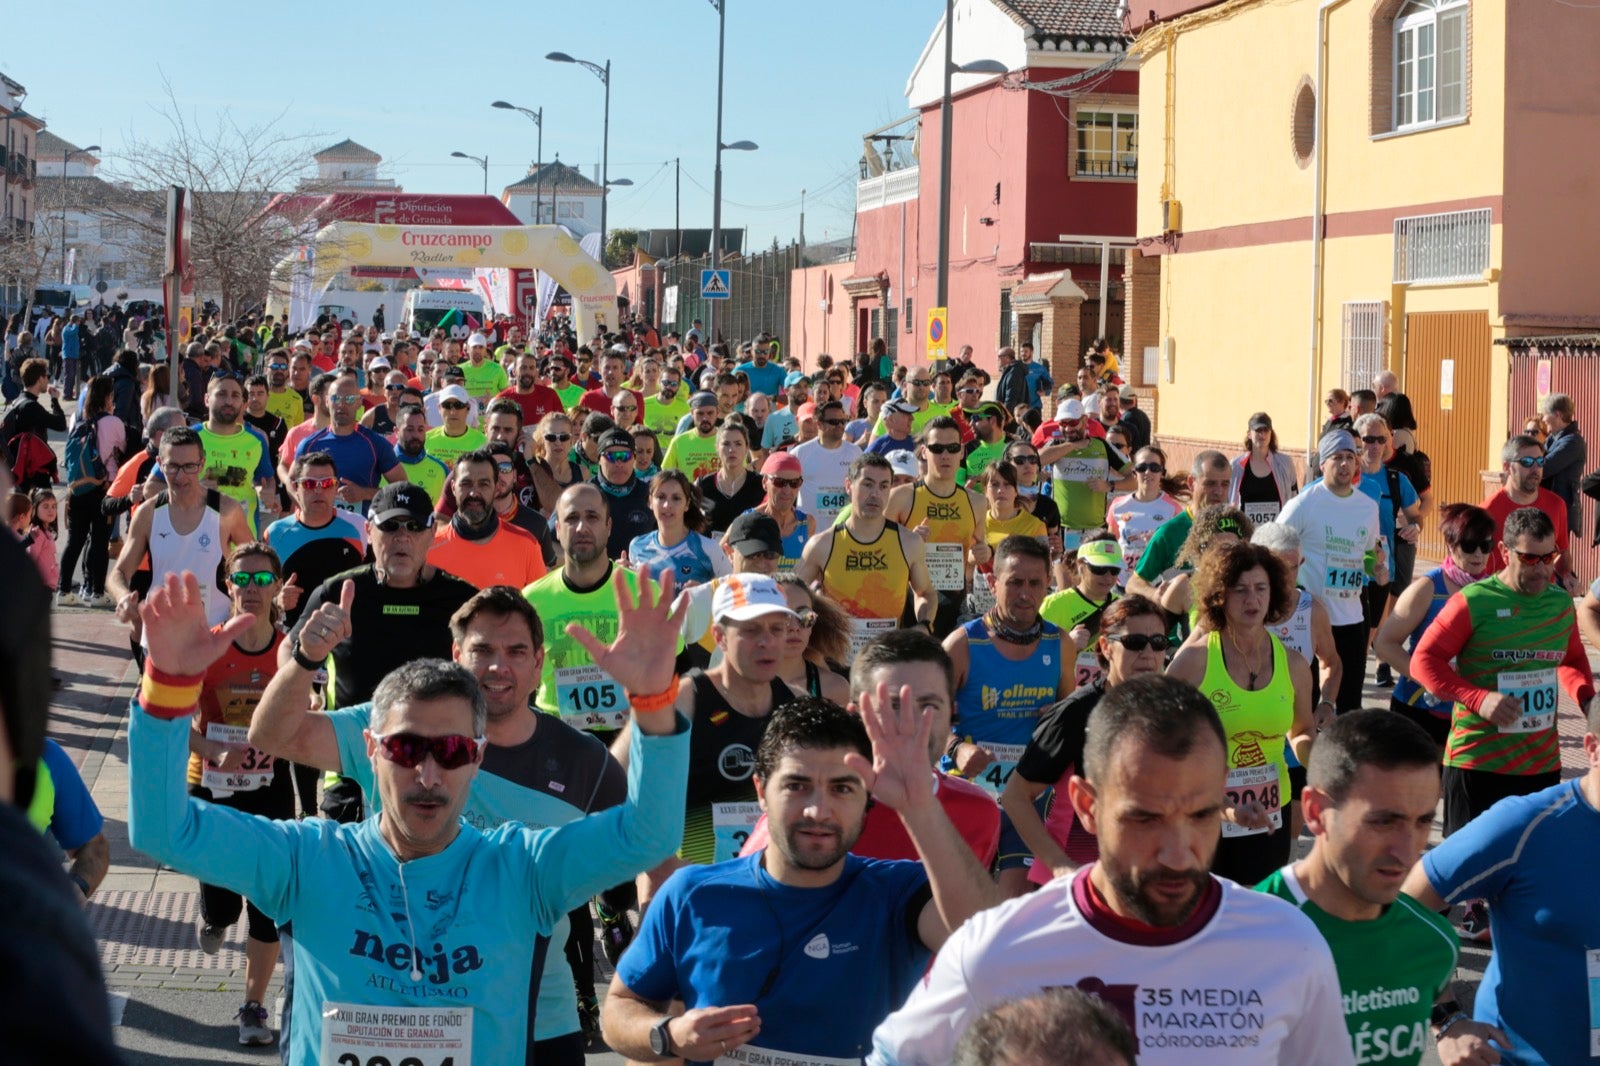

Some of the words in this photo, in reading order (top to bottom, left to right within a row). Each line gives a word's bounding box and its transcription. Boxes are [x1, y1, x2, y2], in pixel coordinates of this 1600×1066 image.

[400, 201, 452, 213] Diputación
[400, 214, 409, 223] de
[411, 214, 452, 224] Granada
[402, 231, 492, 248] Cruzcampo
[410, 250, 454, 263] Radler
[822, 495, 845, 507] 648
[927, 506, 961, 518] BOX
[1249, 513, 1276, 524] 3057
[846, 554, 887, 569] BOX
[945, 568, 959, 578] 23
[1329, 570, 1362, 587] 1146
[569, 684, 617, 710] 105
[1003, 684, 1054, 699] olimpo
[1508, 688, 1555, 713] 103
[808, 943, 827, 952] NGA
[349, 929, 483, 984] nerja
[366, 973, 468, 999] ATLETISMO
[1142, 988, 1172, 1007] 35
[1181, 989, 1263, 1007] MEDIA
[355, 1011, 379, 1025] GRAN
[381, 1013, 416, 1027] PREMIO
[418, 1014, 430, 1026] DE
[432, 1014, 462, 1027] FONDO
[1143, 1007, 1264, 1030] MARATÓN
[347, 1024, 392, 1038] DIPUTACIÓN
[394, 1028, 404, 1038] DE
[407, 1028, 445, 1039] GRANADA
[1143, 1033, 1227, 1048] CÓRDOBA
[750, 1052, 772, 1066] GRAN
